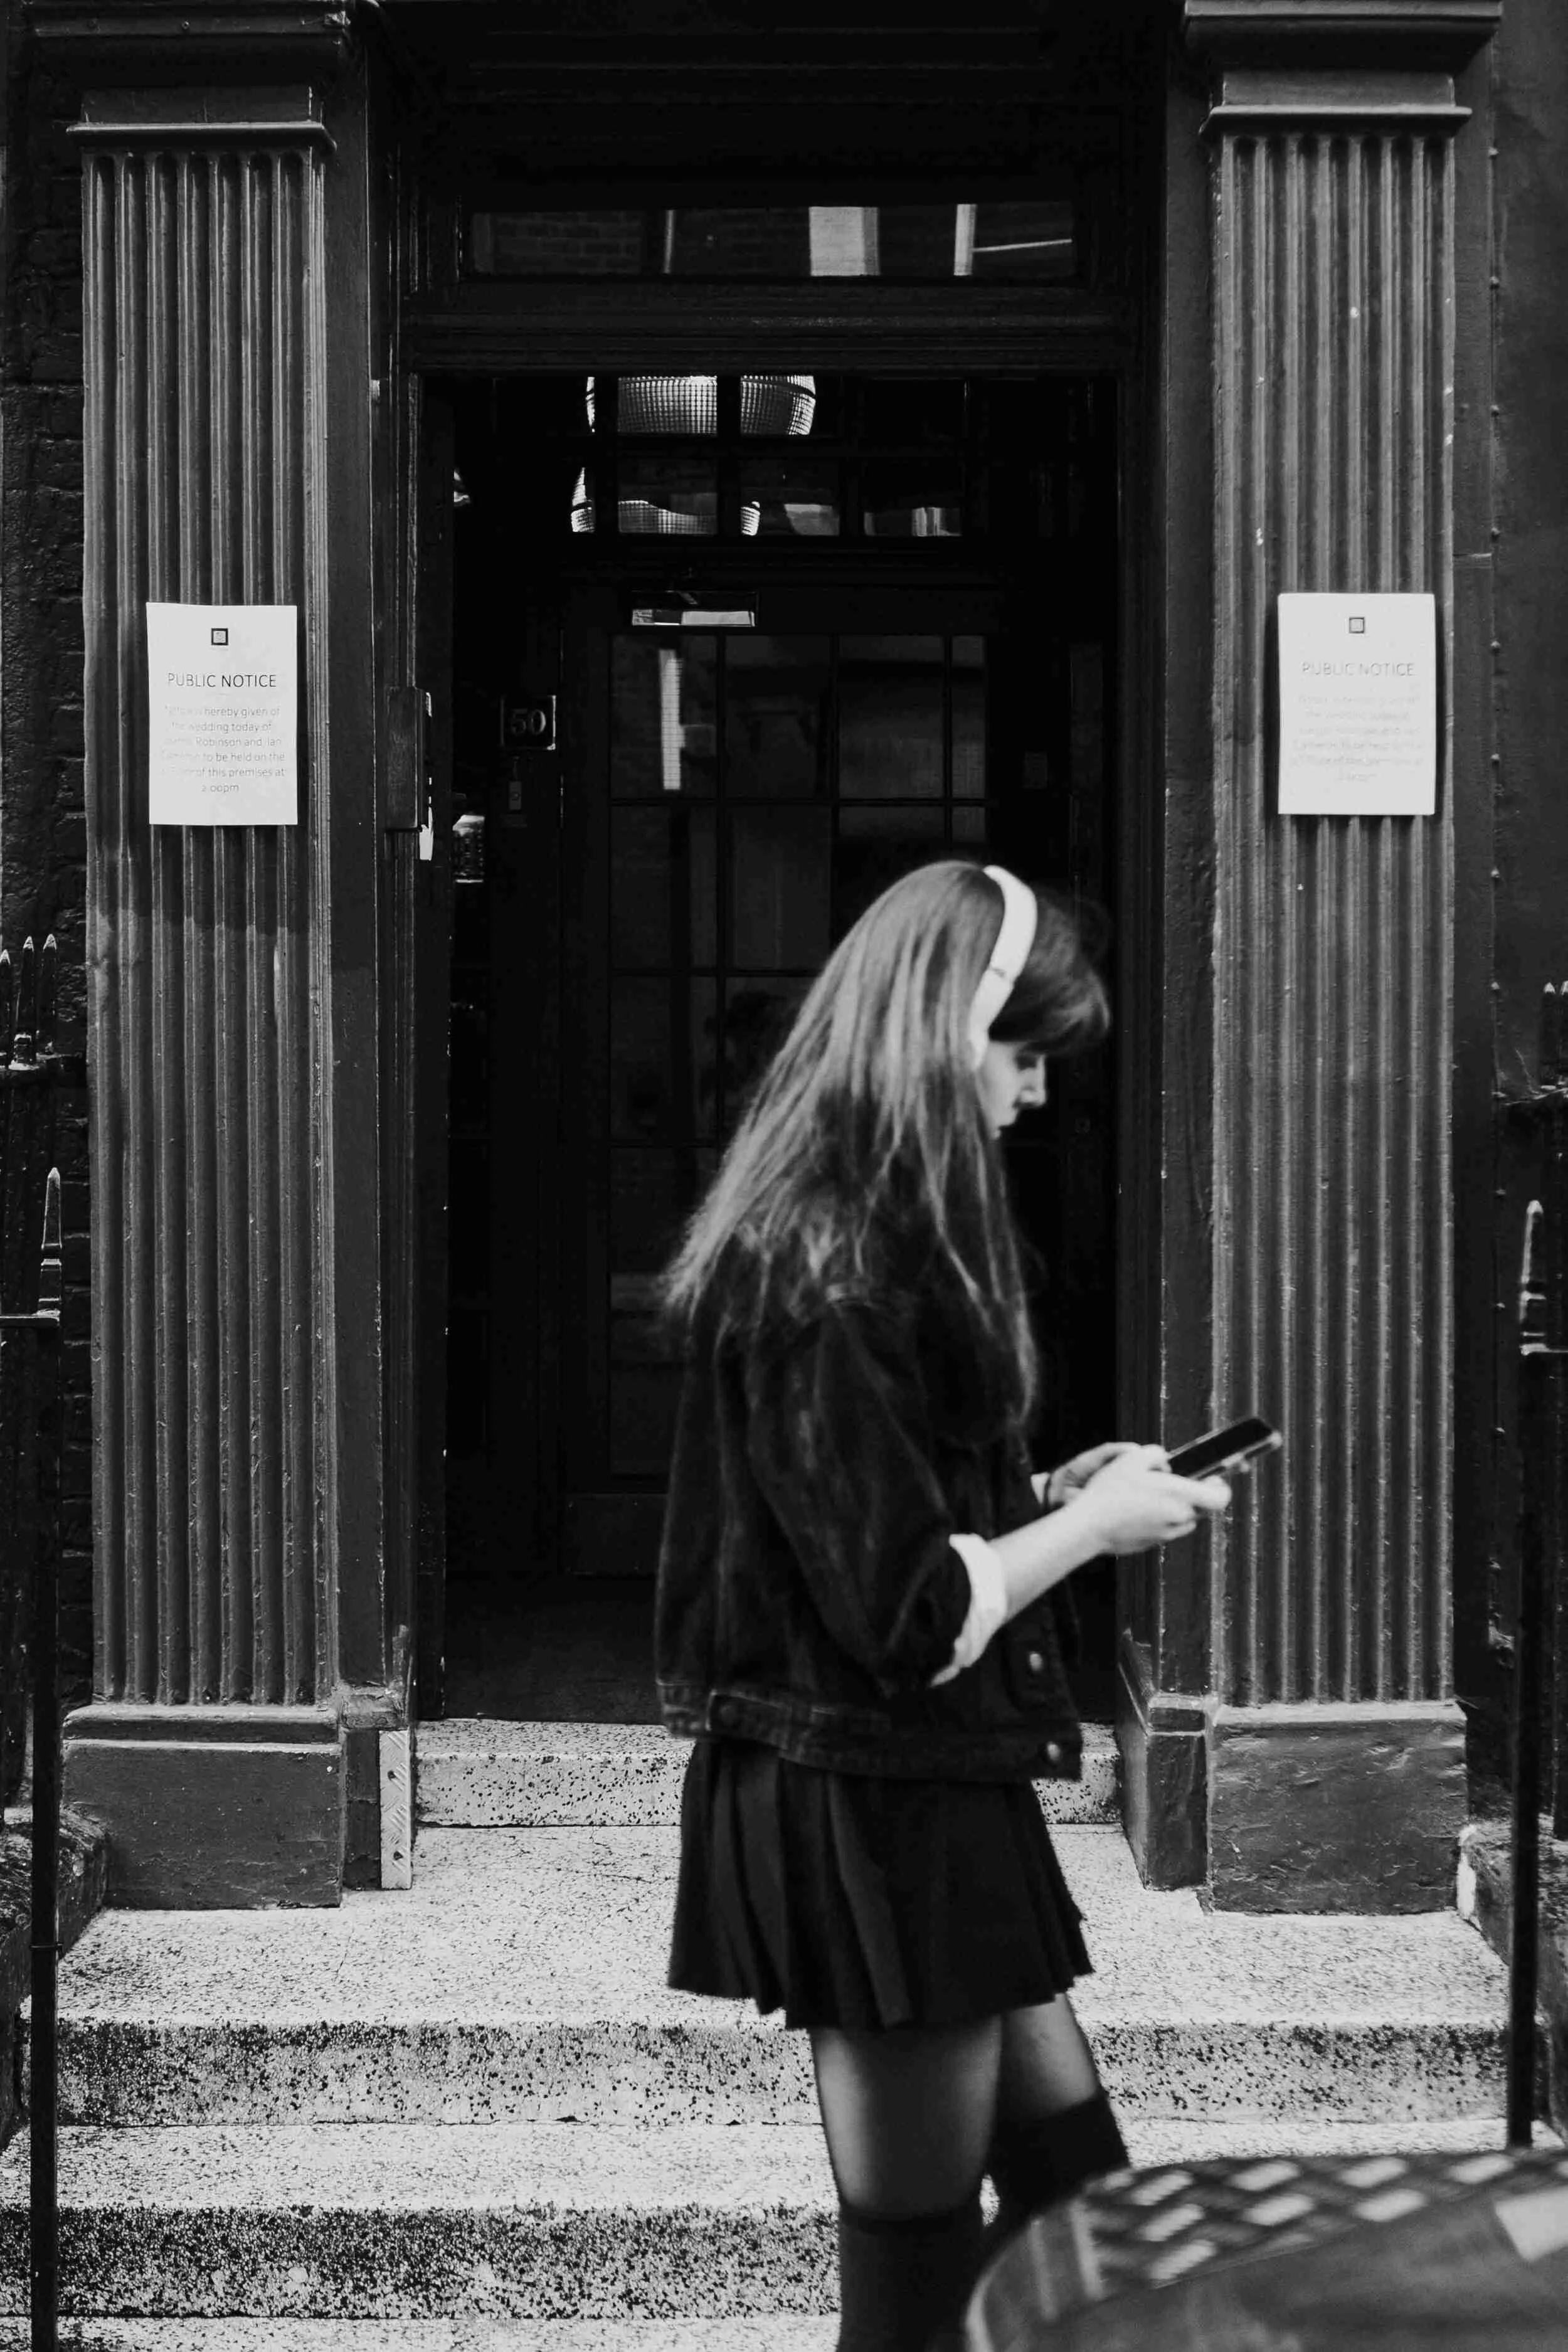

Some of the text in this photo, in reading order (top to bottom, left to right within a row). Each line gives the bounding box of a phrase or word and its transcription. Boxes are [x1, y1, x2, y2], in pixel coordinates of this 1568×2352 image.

[1301, 662, 1416, 676] PUBLIC NOTICE
[167, 672, 277, 688] PUBLIC NOTICE
[204, 705, 240, 718] hereby
[241, 706, 268, 718] given
[270, 705, 280, 716] of
[231, 722, 260, 734] today
[262, 721, 272, 732] of
[510, 708, 547, 736] 50
[196, 736, 241, 747] Robinson
[244, 736, 262, 747] and
[215, 752, 228, 762] be
[230, 752, 252, 762] held
[254, 754, 267, 762] on
[268, 752, 286, 762] the
[208, 767, 226, 778] this
[228, 768, 273, 780] premises
[275, 768, 286, 777] at
